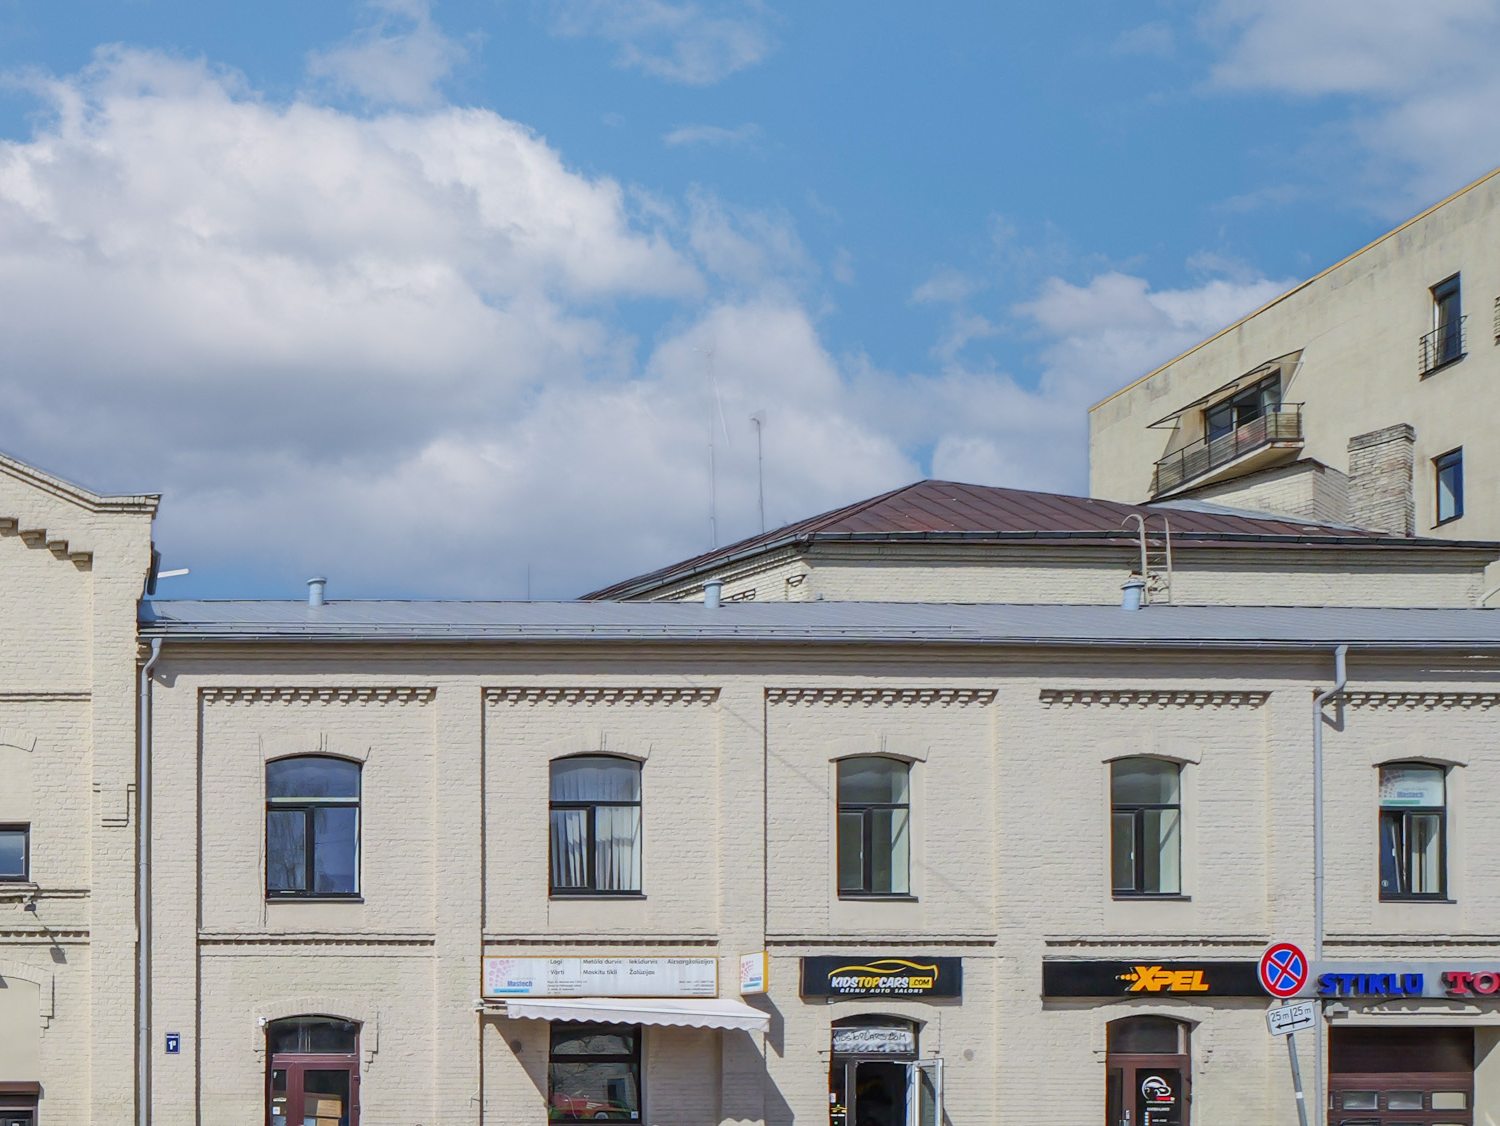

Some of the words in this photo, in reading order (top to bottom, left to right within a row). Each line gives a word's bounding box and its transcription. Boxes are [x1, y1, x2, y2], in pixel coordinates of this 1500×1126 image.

[1129, 965, 1210, 992] XPEL
[1320, 972, 1424, 994] STIKLU
[1446, 970, 1500, 995] TO
[1270, 1012, 1283, 1023] 25
[1293, 1006, 1304, 1017] 25
